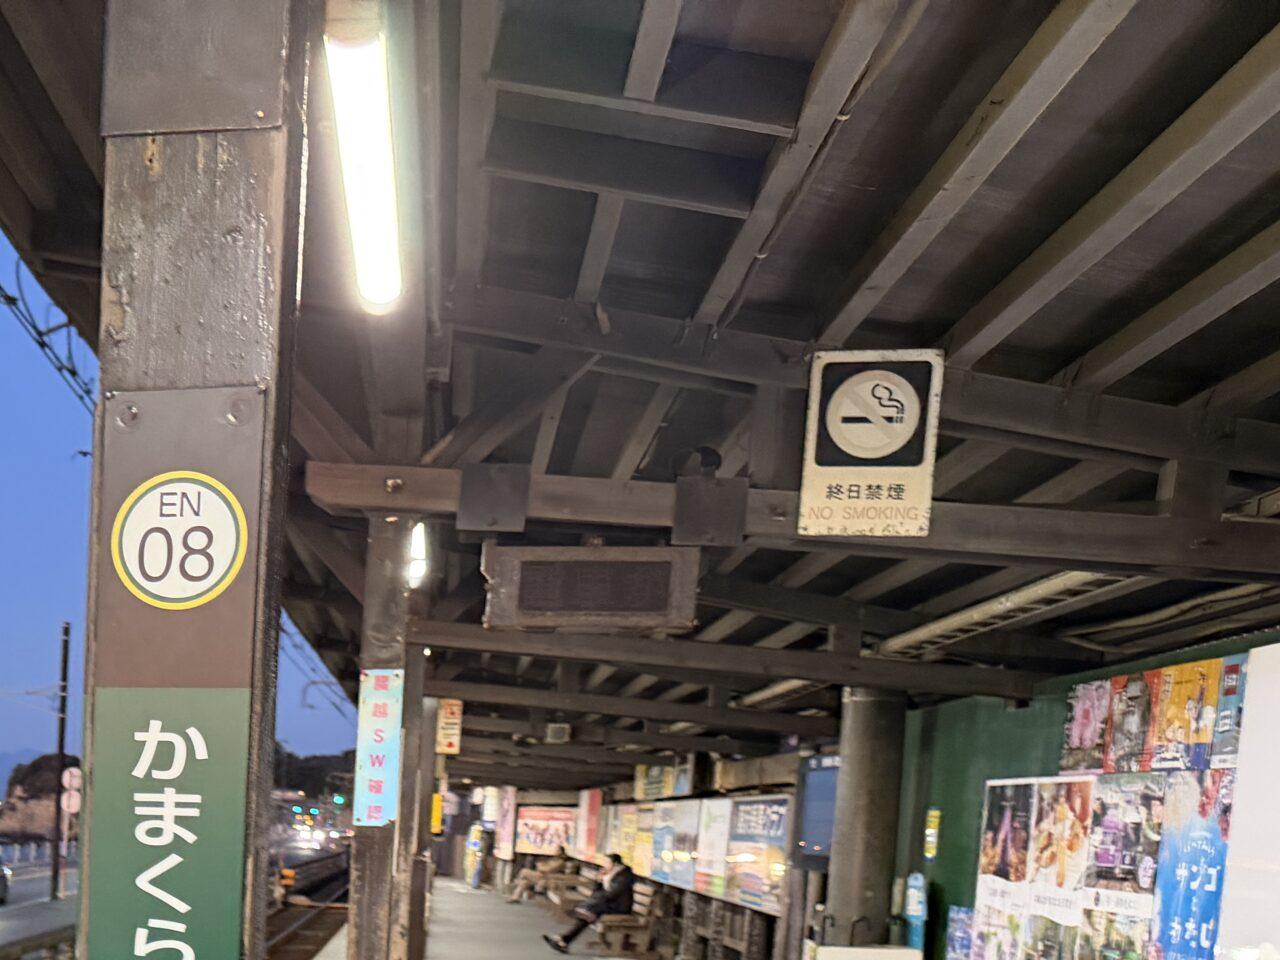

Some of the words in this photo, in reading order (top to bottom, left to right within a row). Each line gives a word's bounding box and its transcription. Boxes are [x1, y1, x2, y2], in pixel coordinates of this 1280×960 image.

[826, 483, 905, 501] 終日禁煙
[159, 491, 201, 518] EN
[808, 506, 833, 521] NO
[842, 506, 919, 521] SMOKING
[138, 525, 215, 583] 08
